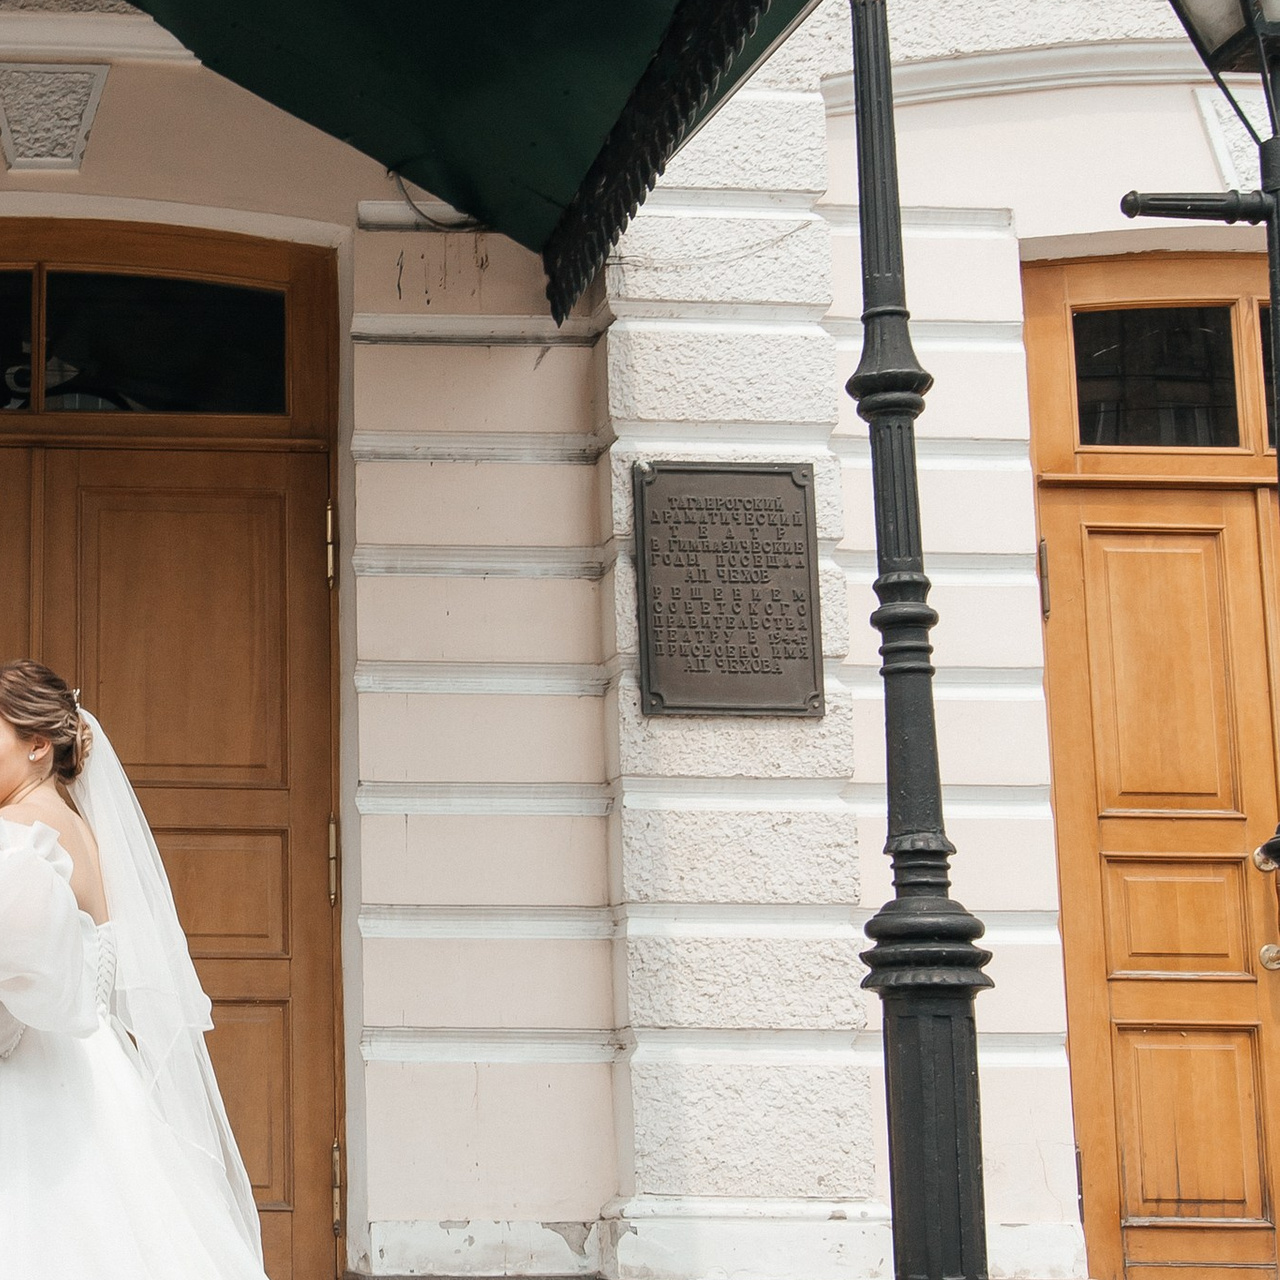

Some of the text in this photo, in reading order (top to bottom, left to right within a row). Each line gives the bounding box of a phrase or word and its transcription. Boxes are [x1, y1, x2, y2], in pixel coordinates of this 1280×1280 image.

[668, 496, 784, 512] ТАГАНРОГСКИЙ
[650, 509, 803, 526] ДРАМАТИЧЕСКИЙ
[669, 525, 786, 540] ТЕАТР
[650, 538, 804, 555] В ГИМНАЗИЧЕСКИЕ
[651, 553, 805, 569] ГОДЫ ПОСЕЩАЛ
[716, 569, 771, 583] ЧЕХОВ
[653, 586, 806, 602] РЕШЕНИЕМ
[653, 601, 807, 617] СОВЕТСКОГО
[653, 615, 808, 631] ПРАВИТЕЛЬСТВА
[654, 629, 734, 643] ТЕАТРУ
[748, 632, 757, 644] В
[655, 644, 809, 659] ПРИСВОЕНО ИМЯ
[715, 659, 783, 674] ЧЕХОВА
